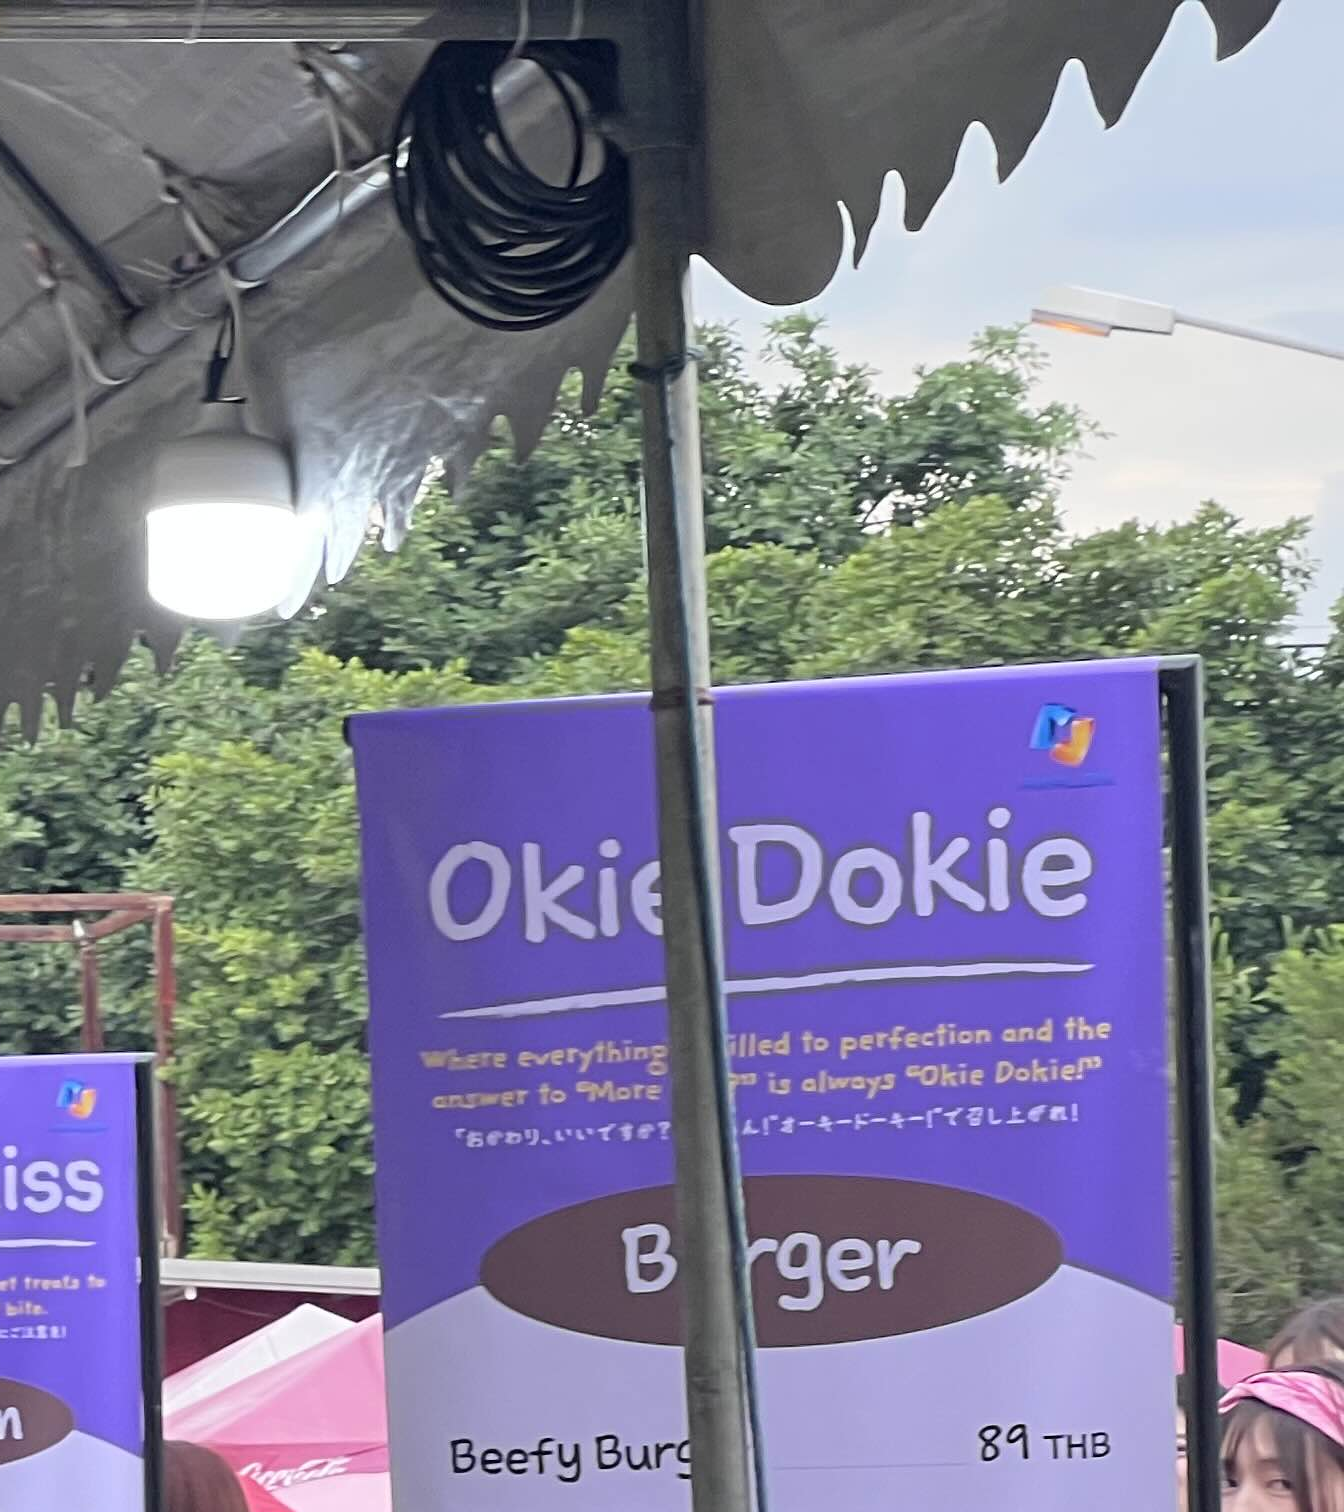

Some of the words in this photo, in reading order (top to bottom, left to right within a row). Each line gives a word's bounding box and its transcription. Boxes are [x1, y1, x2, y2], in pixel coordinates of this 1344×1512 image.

[728, 806, 1095, 927] Dokie
[420, 1049, 507, 1072] Where
[801, 1030, 830, 1054] to
[839, 1023, 993, 1060] perfection
[1001, 1018, 1054, 1043] and
[1064, 1016, 1112, 1041] the
[431, 1089, 529, 1110] answer
[538, 1082, 567, 1105] to
[767, 1069, 791, 1095] is
[800, 1069, 898, 1099] always
[621, 1223, 922, 1313] Brger
[450, 1437, 582, 1484] Beefy
[978, 1423, 1029, 1462] 89
[1043, 1432, 1111, 1460] THB
